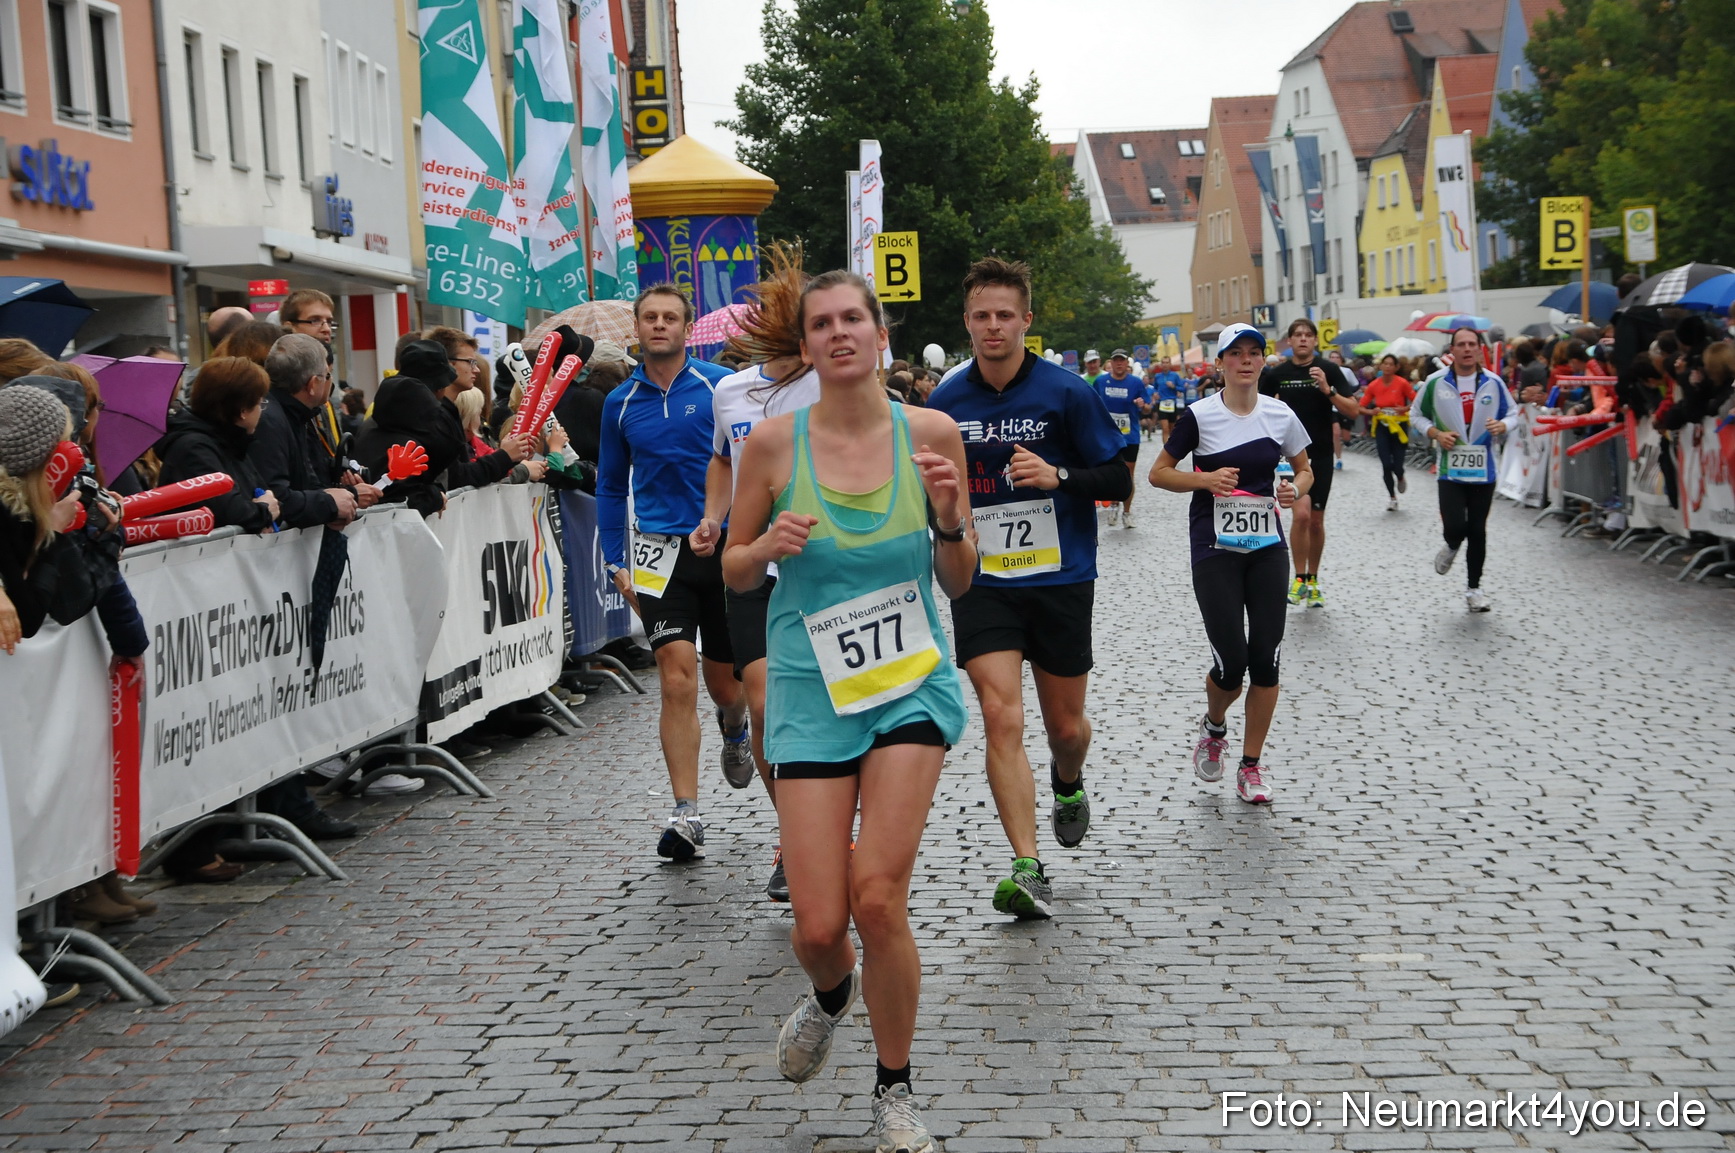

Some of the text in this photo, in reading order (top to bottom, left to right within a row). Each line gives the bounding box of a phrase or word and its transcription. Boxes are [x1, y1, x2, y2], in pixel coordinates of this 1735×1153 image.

[422, 160, 513, 195] dereinigun
[422, 181, 465, 198] rvice
[1547, 200, 1584, 213] Block
[878, 235, 913, 248] Block
[1554, 220, 1575, 252] B
[885, 253, 908, 286] B
[440, 270, 503, 306] 6352
[1324, 328, 1334, 344] C
[521, 378, 538, 407] BKK
[537, 389, 557, 412] BKK
[1001, 418, 1048, 435] HiRo
[1001, 432, 1046, 442] Run 21.1
[1452, 454, 1484, 468] 2790
[975, 507, 1040, 523] PARTL Neumarkt
[1222, 511, 1269, 533] 2501
[125, 524, 160, 541] BKK
[999, 520, 1033, 549] 72
[1237, 538, 1260, 547] Katrin
[1002, 554, 1036, 568] Daniel
[809, 597, 901, 635] PARTL Neumarkt
[155, 578, 365, 698] BMW EfficientDynmics
[837, 612, 904, 669] 577
[154, 711, 207, 768] Weniger
[209, 682, 267, 745] Verbrauch.
